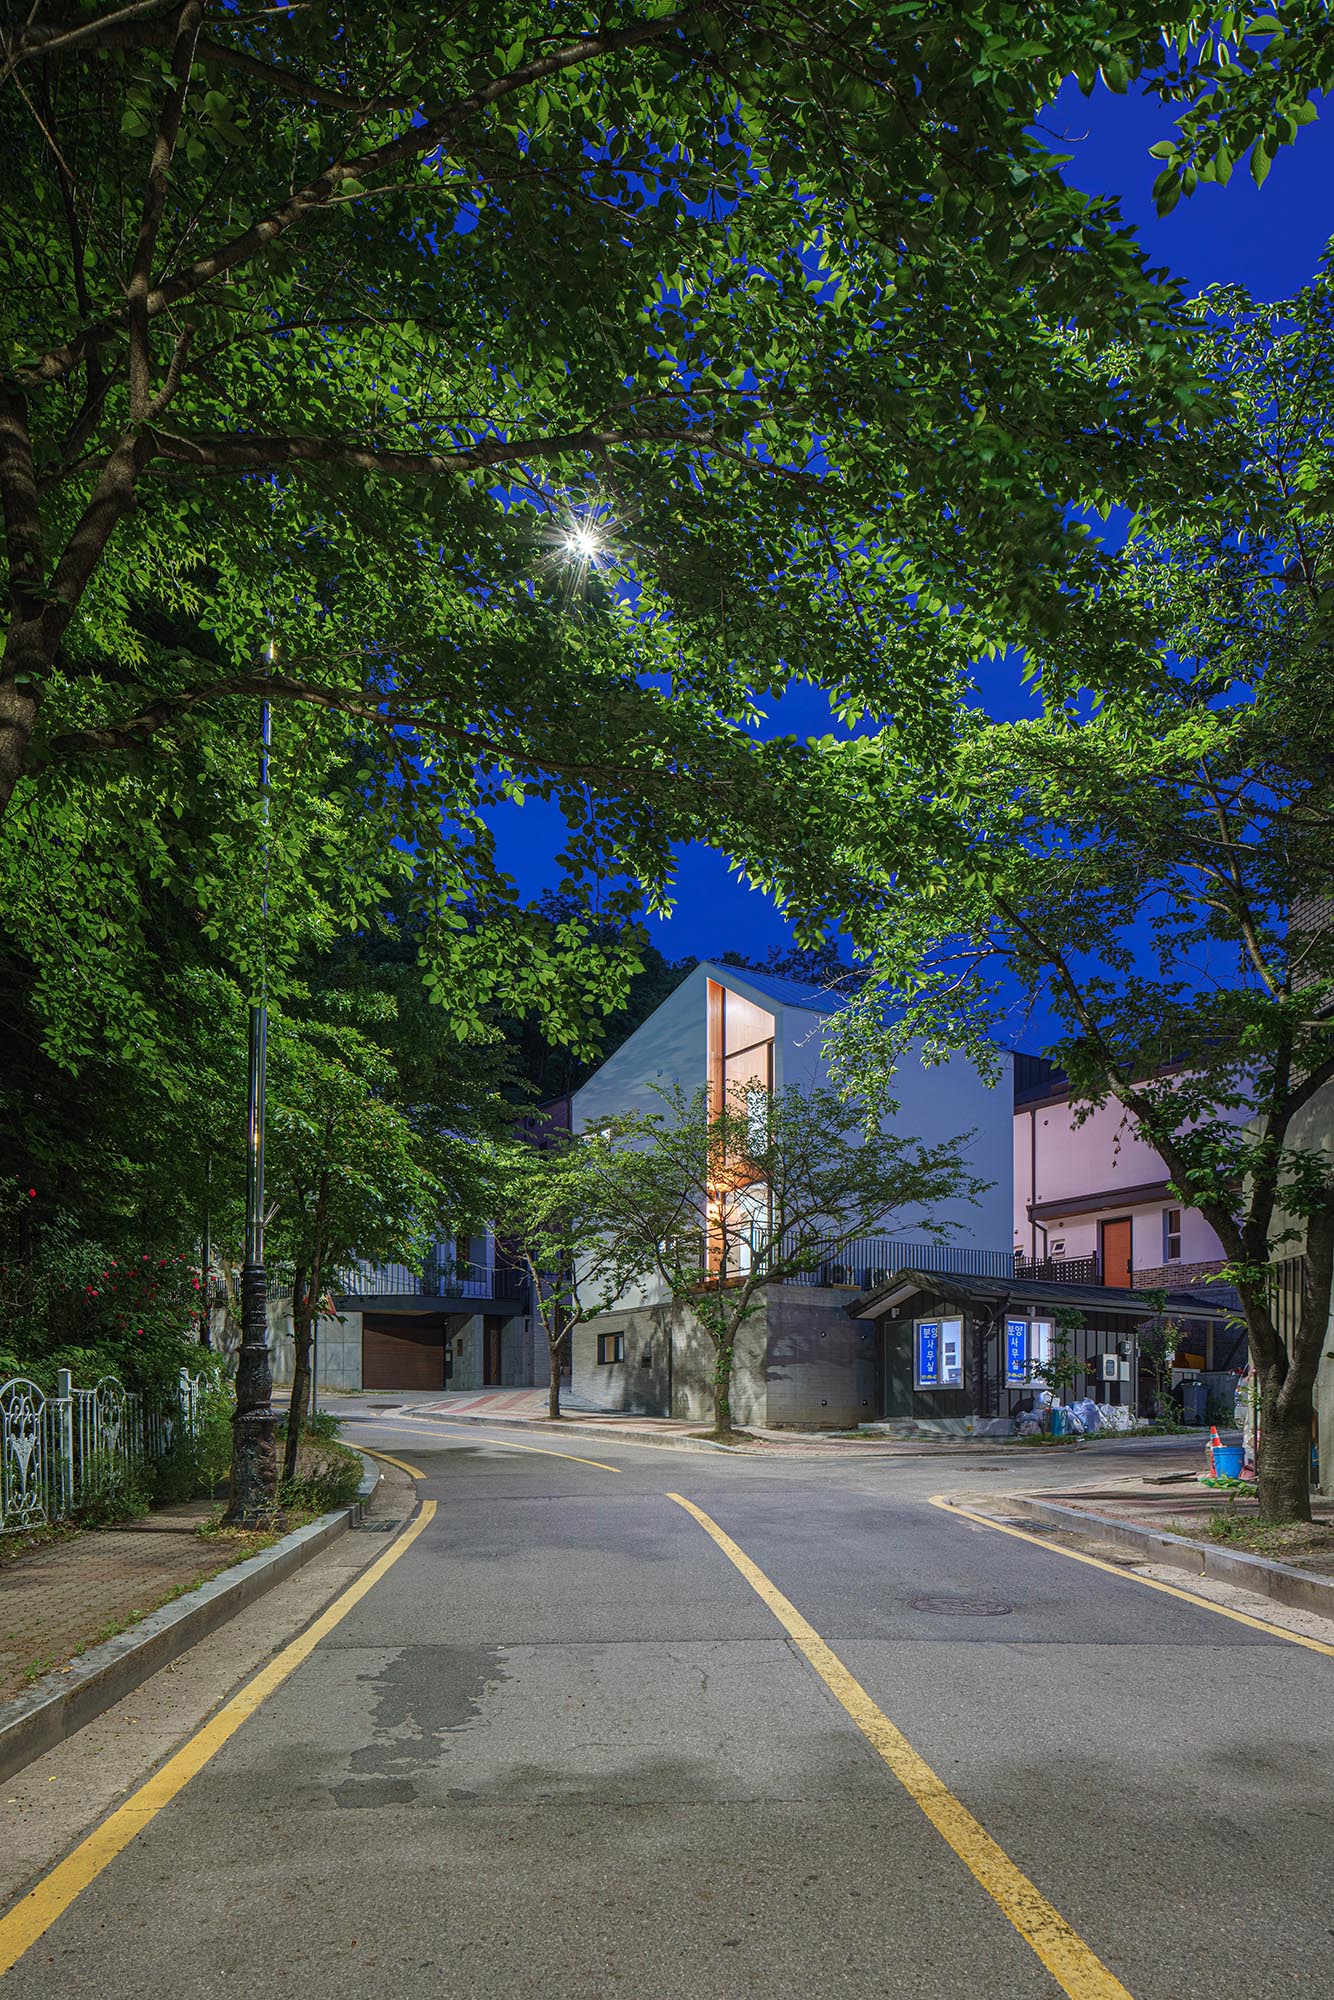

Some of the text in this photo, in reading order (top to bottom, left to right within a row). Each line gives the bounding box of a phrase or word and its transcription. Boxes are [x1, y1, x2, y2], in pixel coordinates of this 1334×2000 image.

[923, 1328, 937, 1338] 분양
[1008, 1326, 1023, 1336] 분양
[926, 1340, 934, 1372] 사무실
[1011, 1338, 1019, 1370] 사무실
